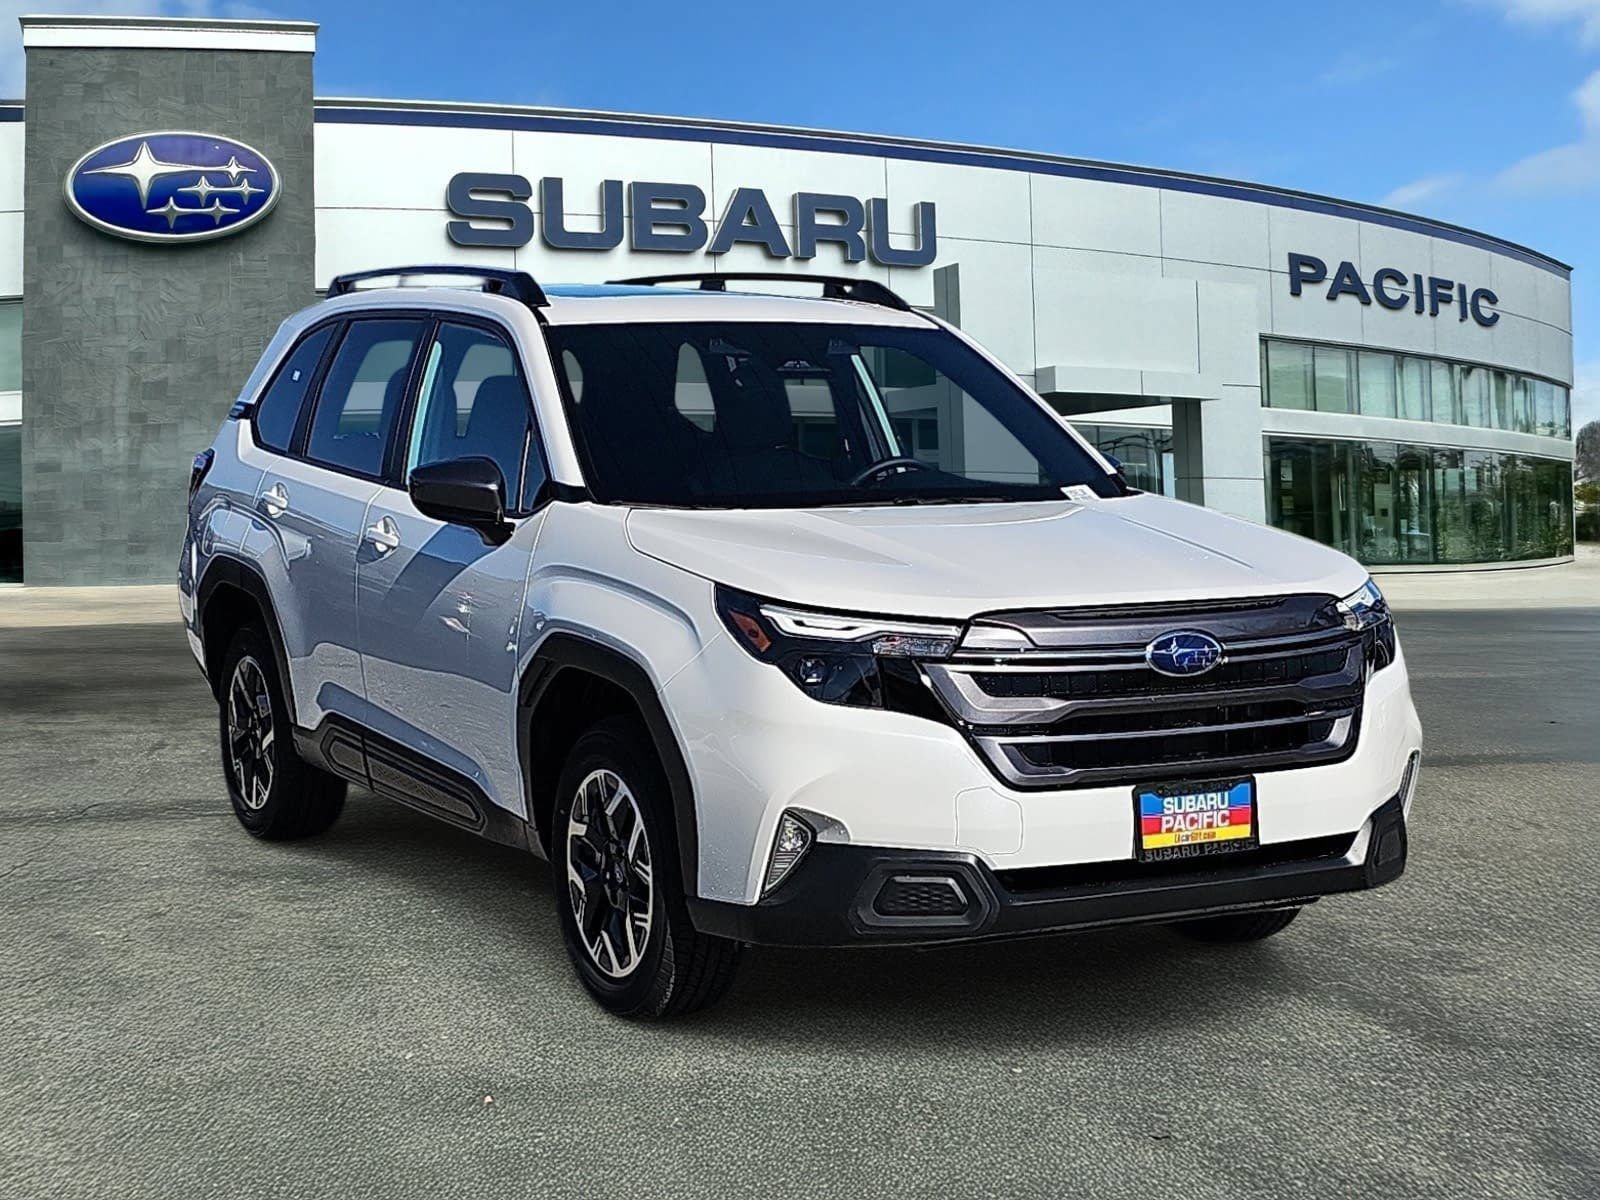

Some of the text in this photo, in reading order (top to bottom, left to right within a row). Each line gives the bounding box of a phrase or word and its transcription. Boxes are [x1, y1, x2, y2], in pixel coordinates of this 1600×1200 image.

[447, 172, 936, 266] SUBARU
[1288, 252, 1500, 327] PACIFIC
[1163, 792, 1229, 814] SUBARU
[1161, 810, 1230, 833] PACIFIC
[1144, 845, 1200, 862] SUBARU
